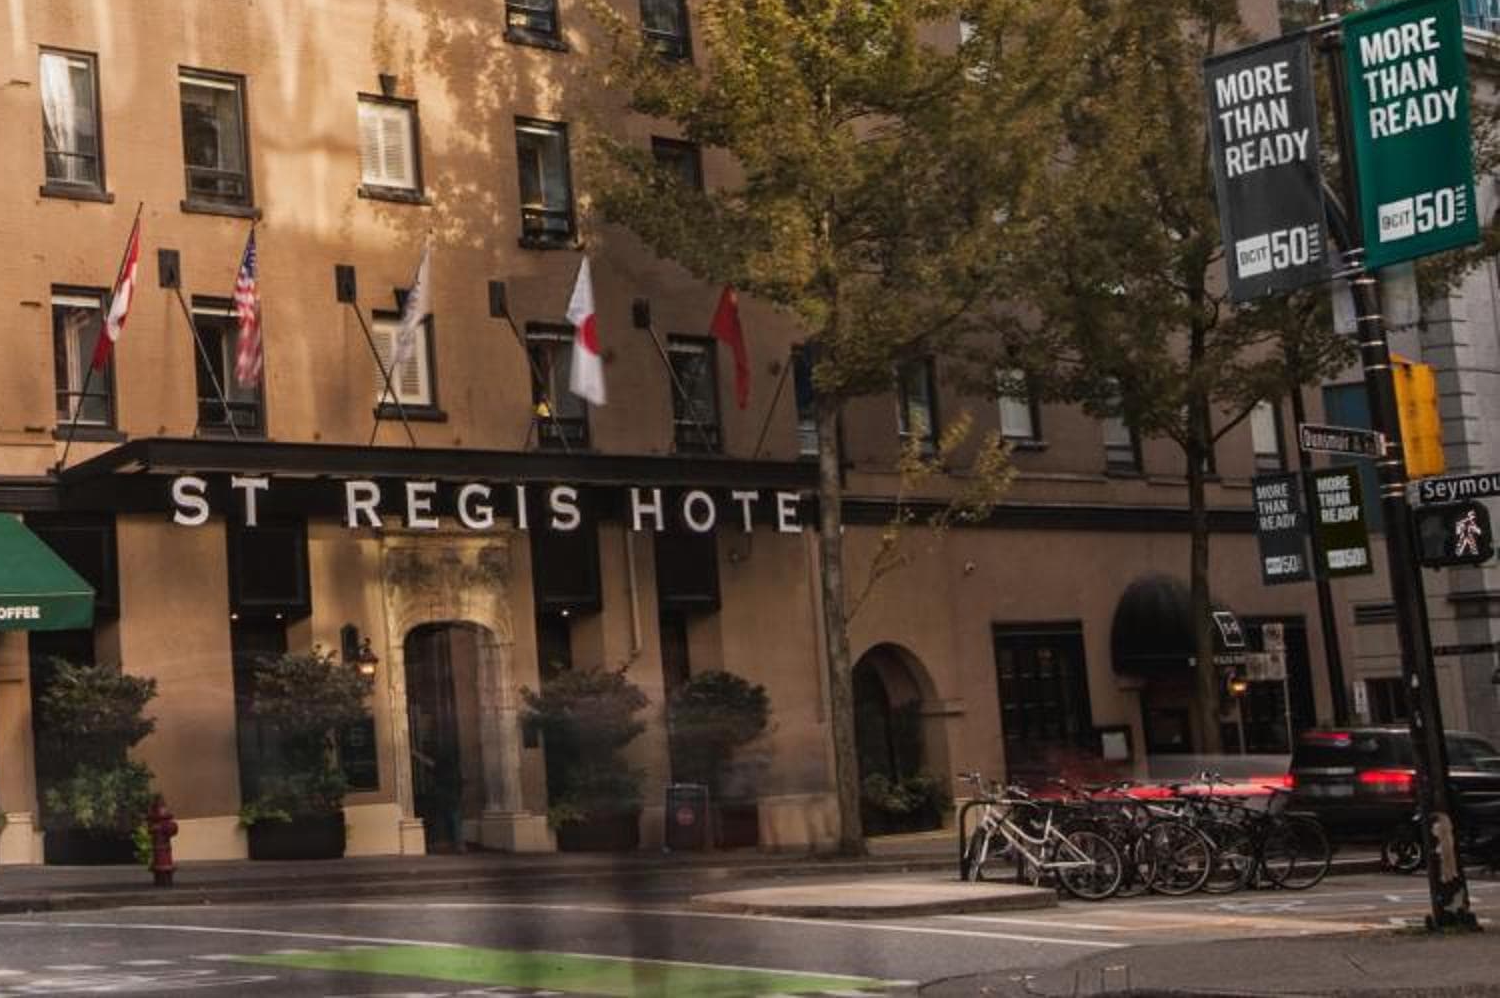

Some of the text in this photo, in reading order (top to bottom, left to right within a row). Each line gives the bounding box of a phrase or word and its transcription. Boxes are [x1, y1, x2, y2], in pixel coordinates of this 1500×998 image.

[1360, 17, 1440, 68] MORE
[1215, 61, 1292, 109] MORE
[1363, 55, 1439, 103] THAN
[1220, 98, 1289, 143] THAN
[1369, 87, 1459, 139] READY
[1225, 128, 1309, 178] READY
[1415, 187, 1455, 233] 50
[1271, 227, 1309, 270] 50
[172, 475, 844, 534] ST REGIS HOTE
[1256, 483, 1288, 499] MORE
[1316, 475, 1351, 492] MORE
[1318, 491, 1350, 507] THAN
[1258, 500, 1288, 514] THAN
[1260, 513, 1297, 530] READY
[1321, 505, 1359, 522] READY
